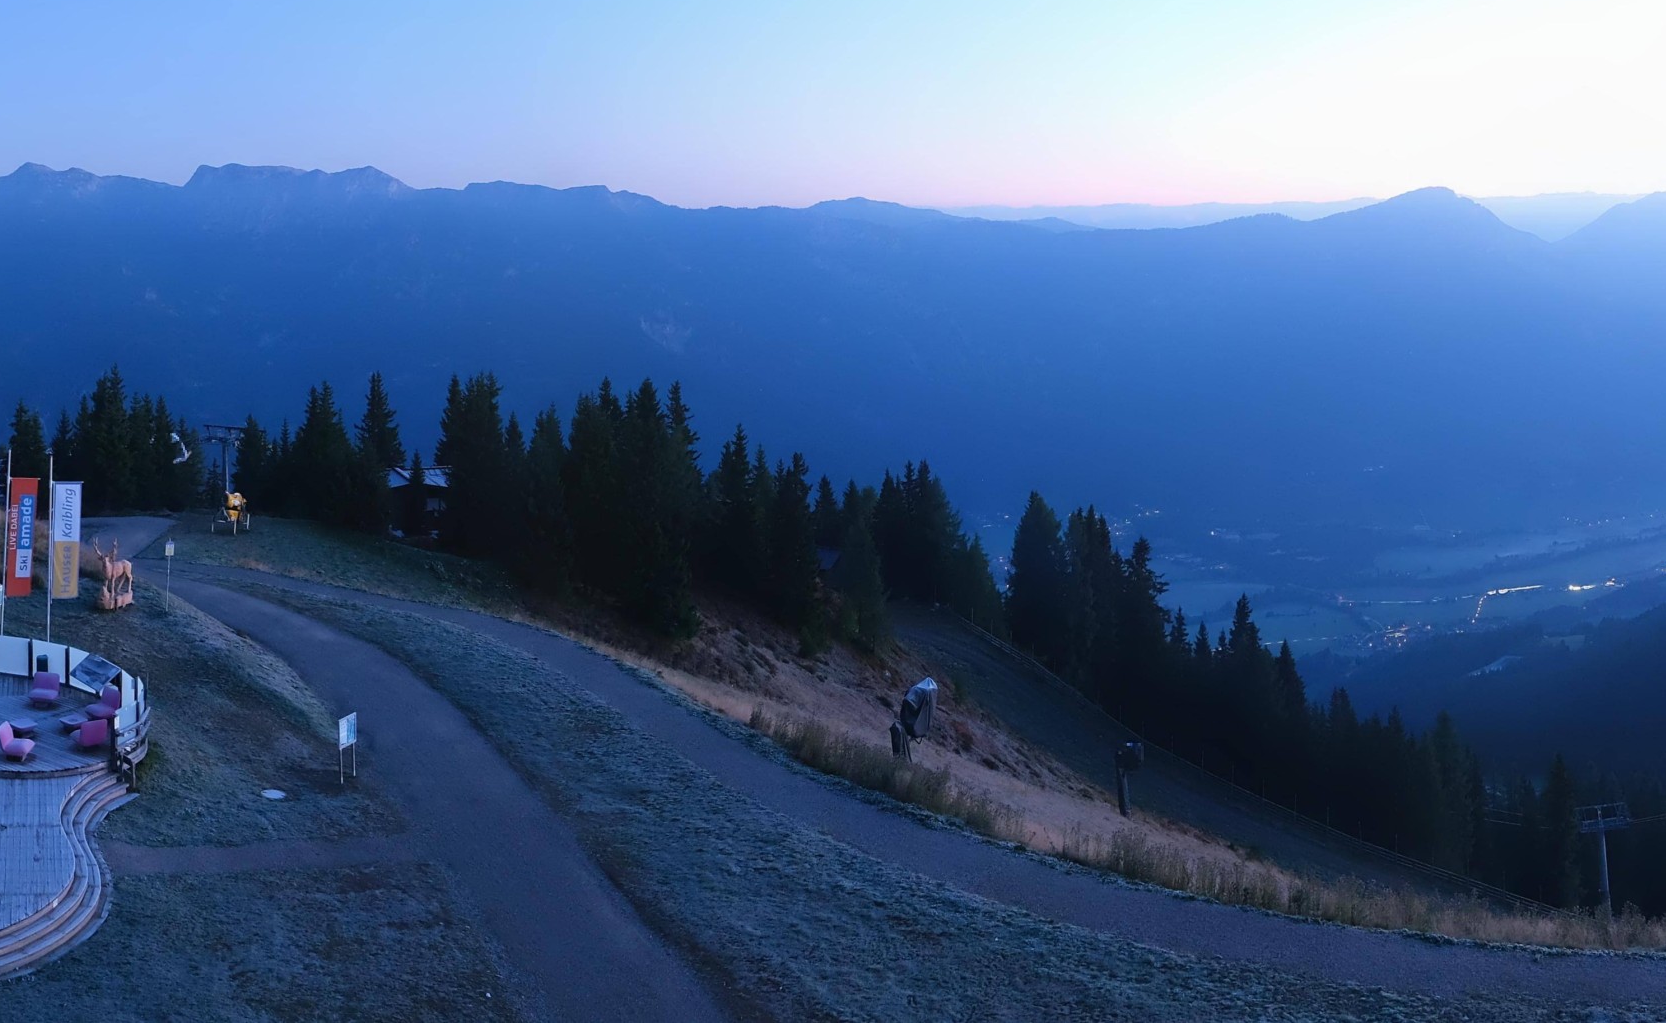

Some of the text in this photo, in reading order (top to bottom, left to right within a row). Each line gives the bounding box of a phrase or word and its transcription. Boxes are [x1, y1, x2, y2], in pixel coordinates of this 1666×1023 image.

[9, 504, 19, 550] LIVE DABEI
[61, 488, 76, 538] Kaibling
[19, 554, 28, 571] Ski
